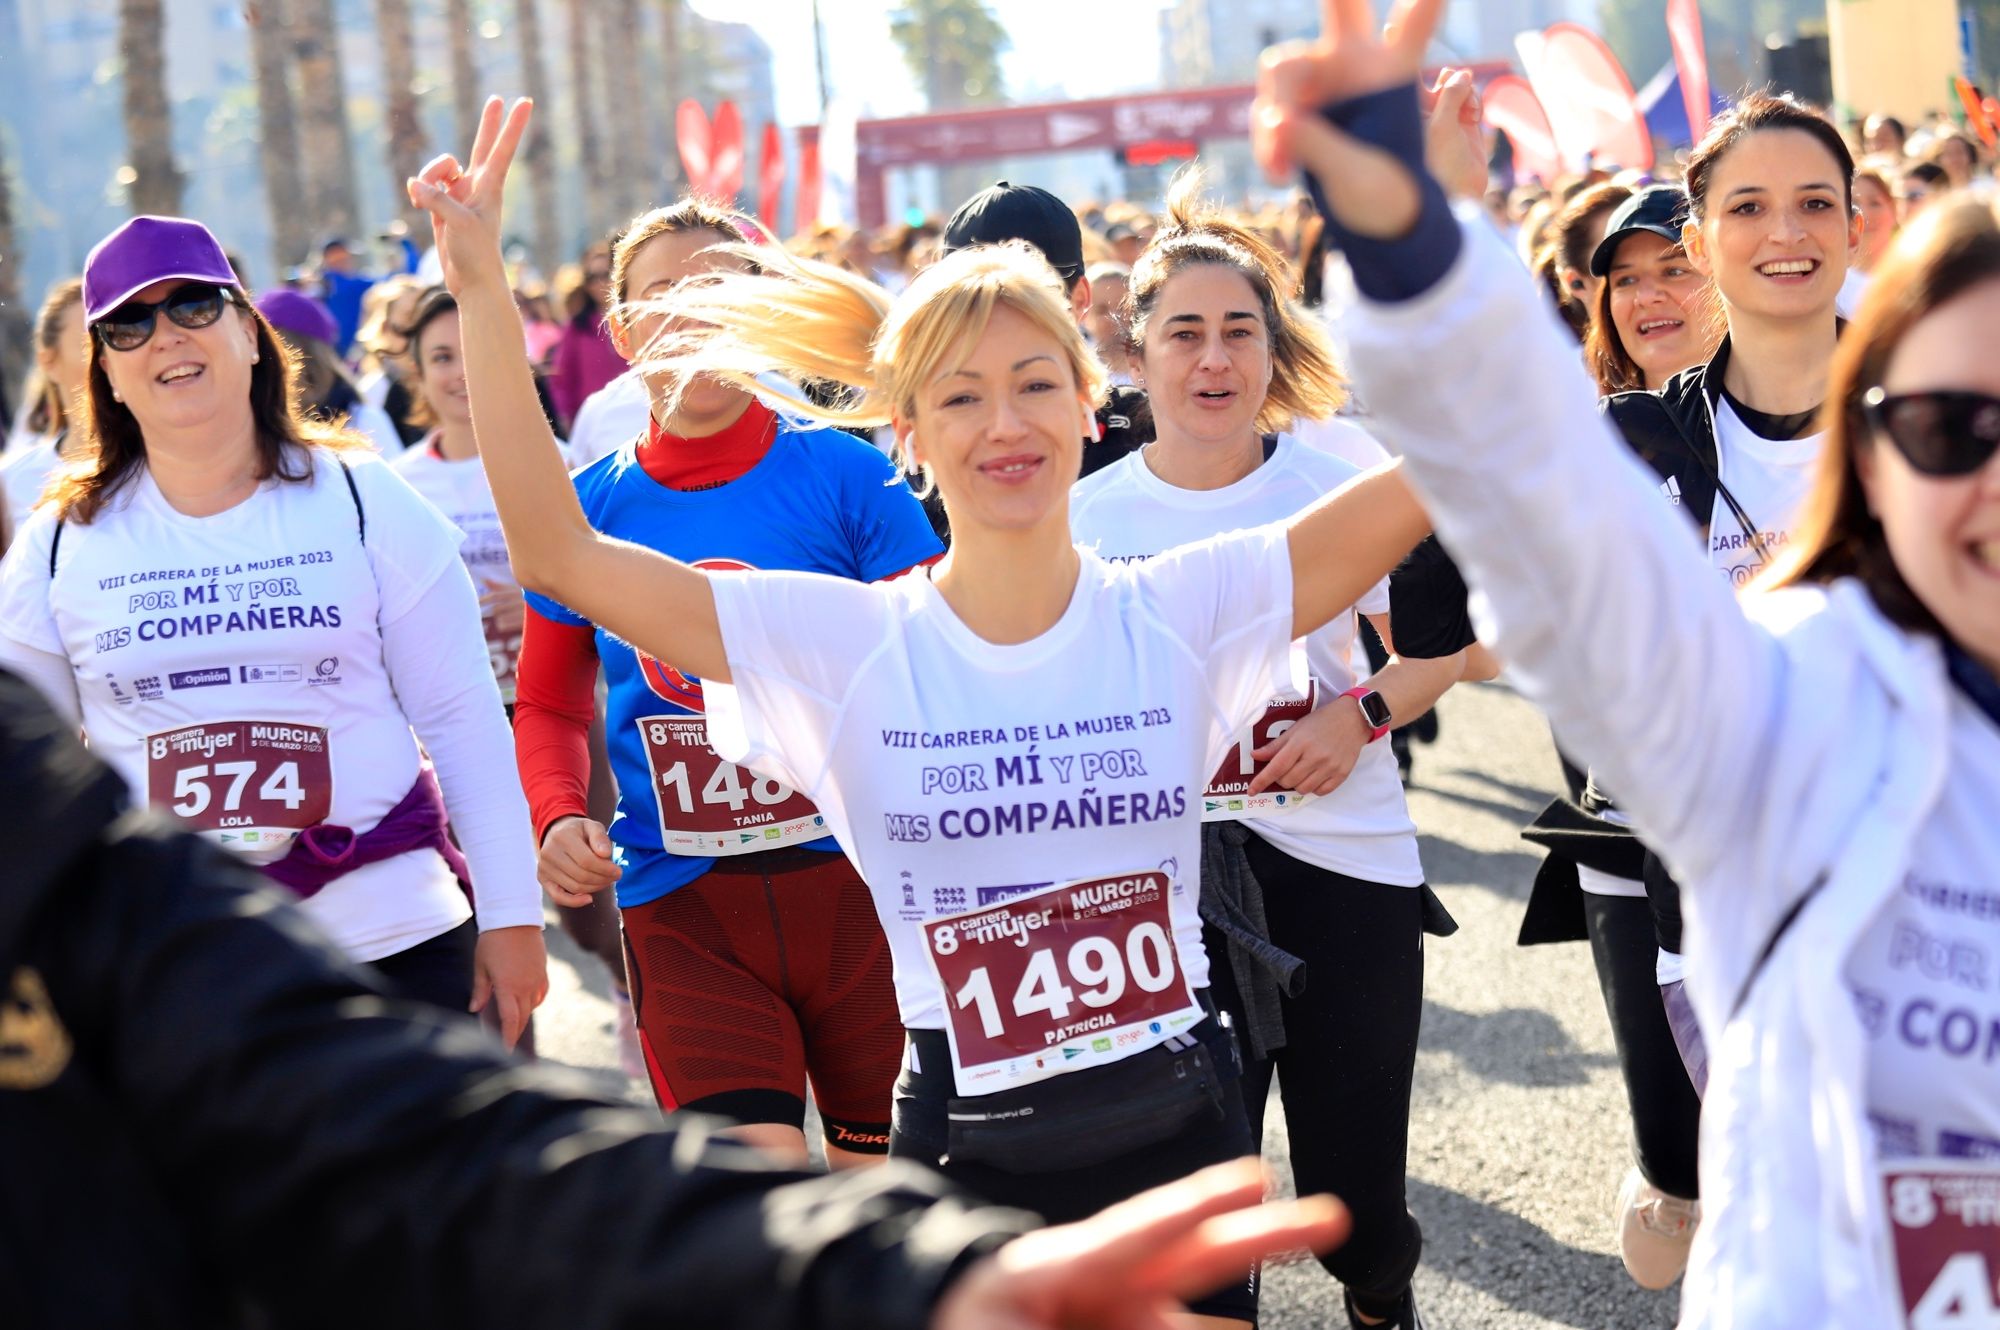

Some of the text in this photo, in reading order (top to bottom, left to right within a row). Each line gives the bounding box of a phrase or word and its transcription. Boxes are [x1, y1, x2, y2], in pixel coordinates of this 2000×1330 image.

[99, 550, 334, 591] VIII CARRERA DE LA MUJER 2023
[128, 577, 302, 614] POR MÍ Y POR
[95, 603, 342, 653] MIS COMPAÑERAS
[170, 728, 205, 742] carrera
[251, 726, 322, 744] MURCIA
[180, 732, 236, 758] mujer
[271, 741, 302, 750] MARZO
[668, 723, 704, 731] carrera
[882, 730, 917, 749] VIII
[920, 728, 1008, 750] CARRERA
[1014, 725, 1040, 743] DE
[1045, 724, 1070, 740] LA
[1075, 715, 1137, 738] MUJER
[922, 745, 1148, 795] POR MÍ Y POR
[172, 761, 306, 817] 574
[219, 816, 254, 827] LOLA
[733, 812, 775, 827] TANIA
[885, 786, 1186, 842] MIS COMPAÑERAS
[959, 909, 1011, 931] carrera
[1070, 877, 1158, 911] MURCIA
[1073, 892, 1160, 921] 5 DE MARZO 2023
[976, 909, 1053, 947] mujer
[955, 921, 1176, 1039] 1490
[1044, 1013, 1117, 1044] PATRICIA
[1908, 1253, 2000, 1330] 4
